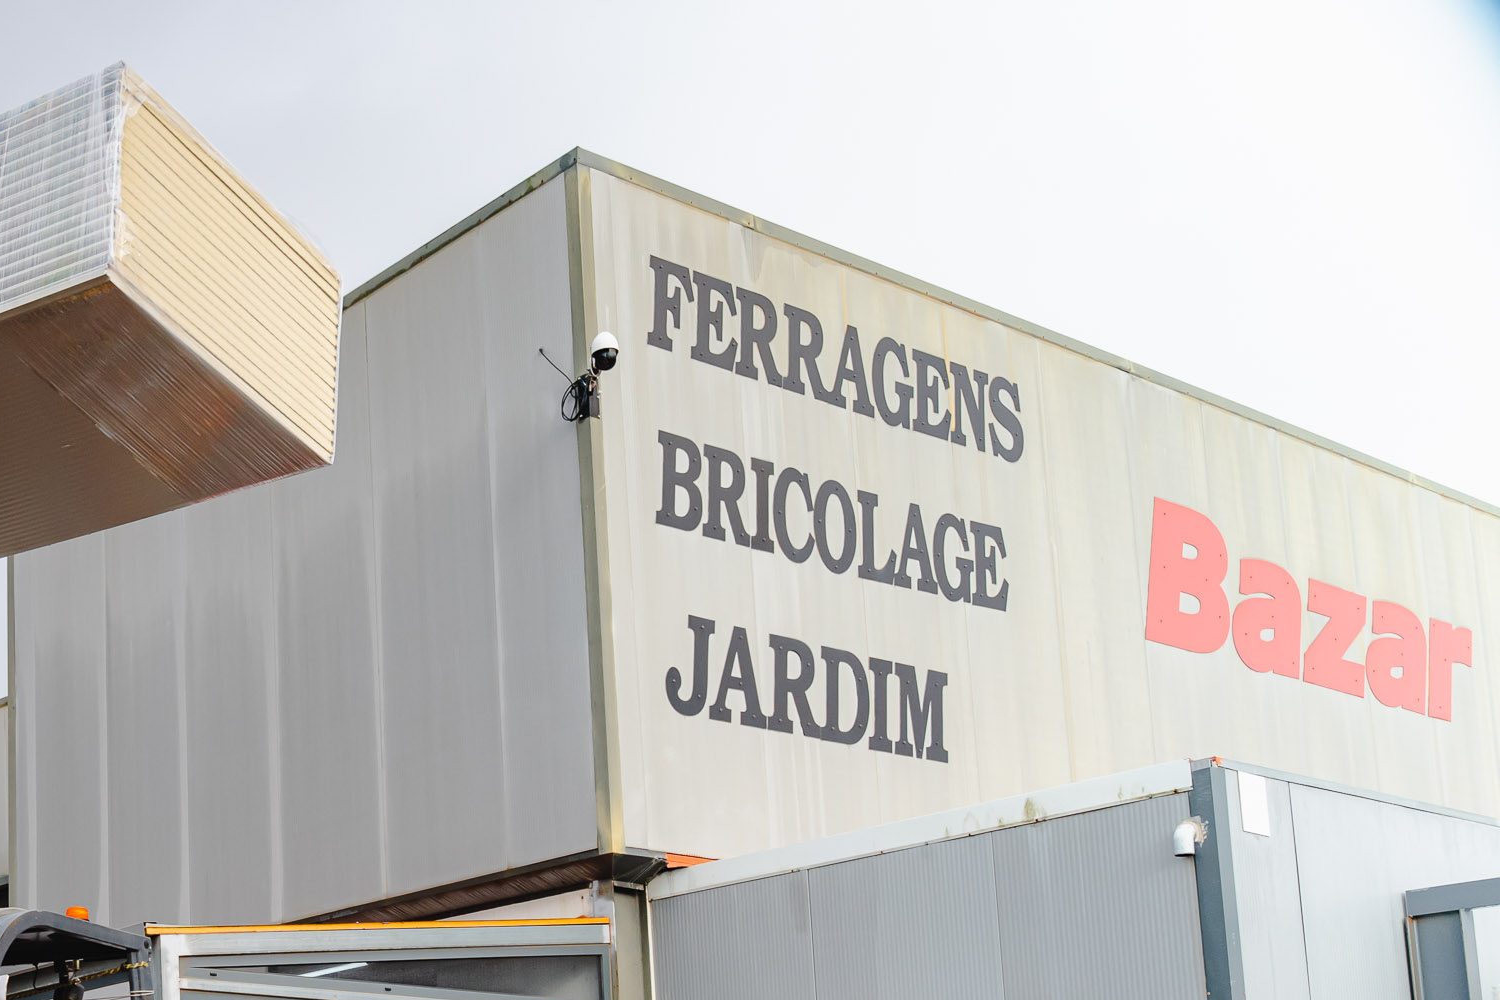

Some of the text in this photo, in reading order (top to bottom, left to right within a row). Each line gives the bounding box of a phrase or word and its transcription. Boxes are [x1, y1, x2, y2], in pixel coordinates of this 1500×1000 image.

[647, 254, 1024, 463] FERRAGENS
[655, 429, 1010, 612] BRICOLAGE
[1145, 496, 1473, 722] Bazar
[665, 614, 950, 764] JARDIM
